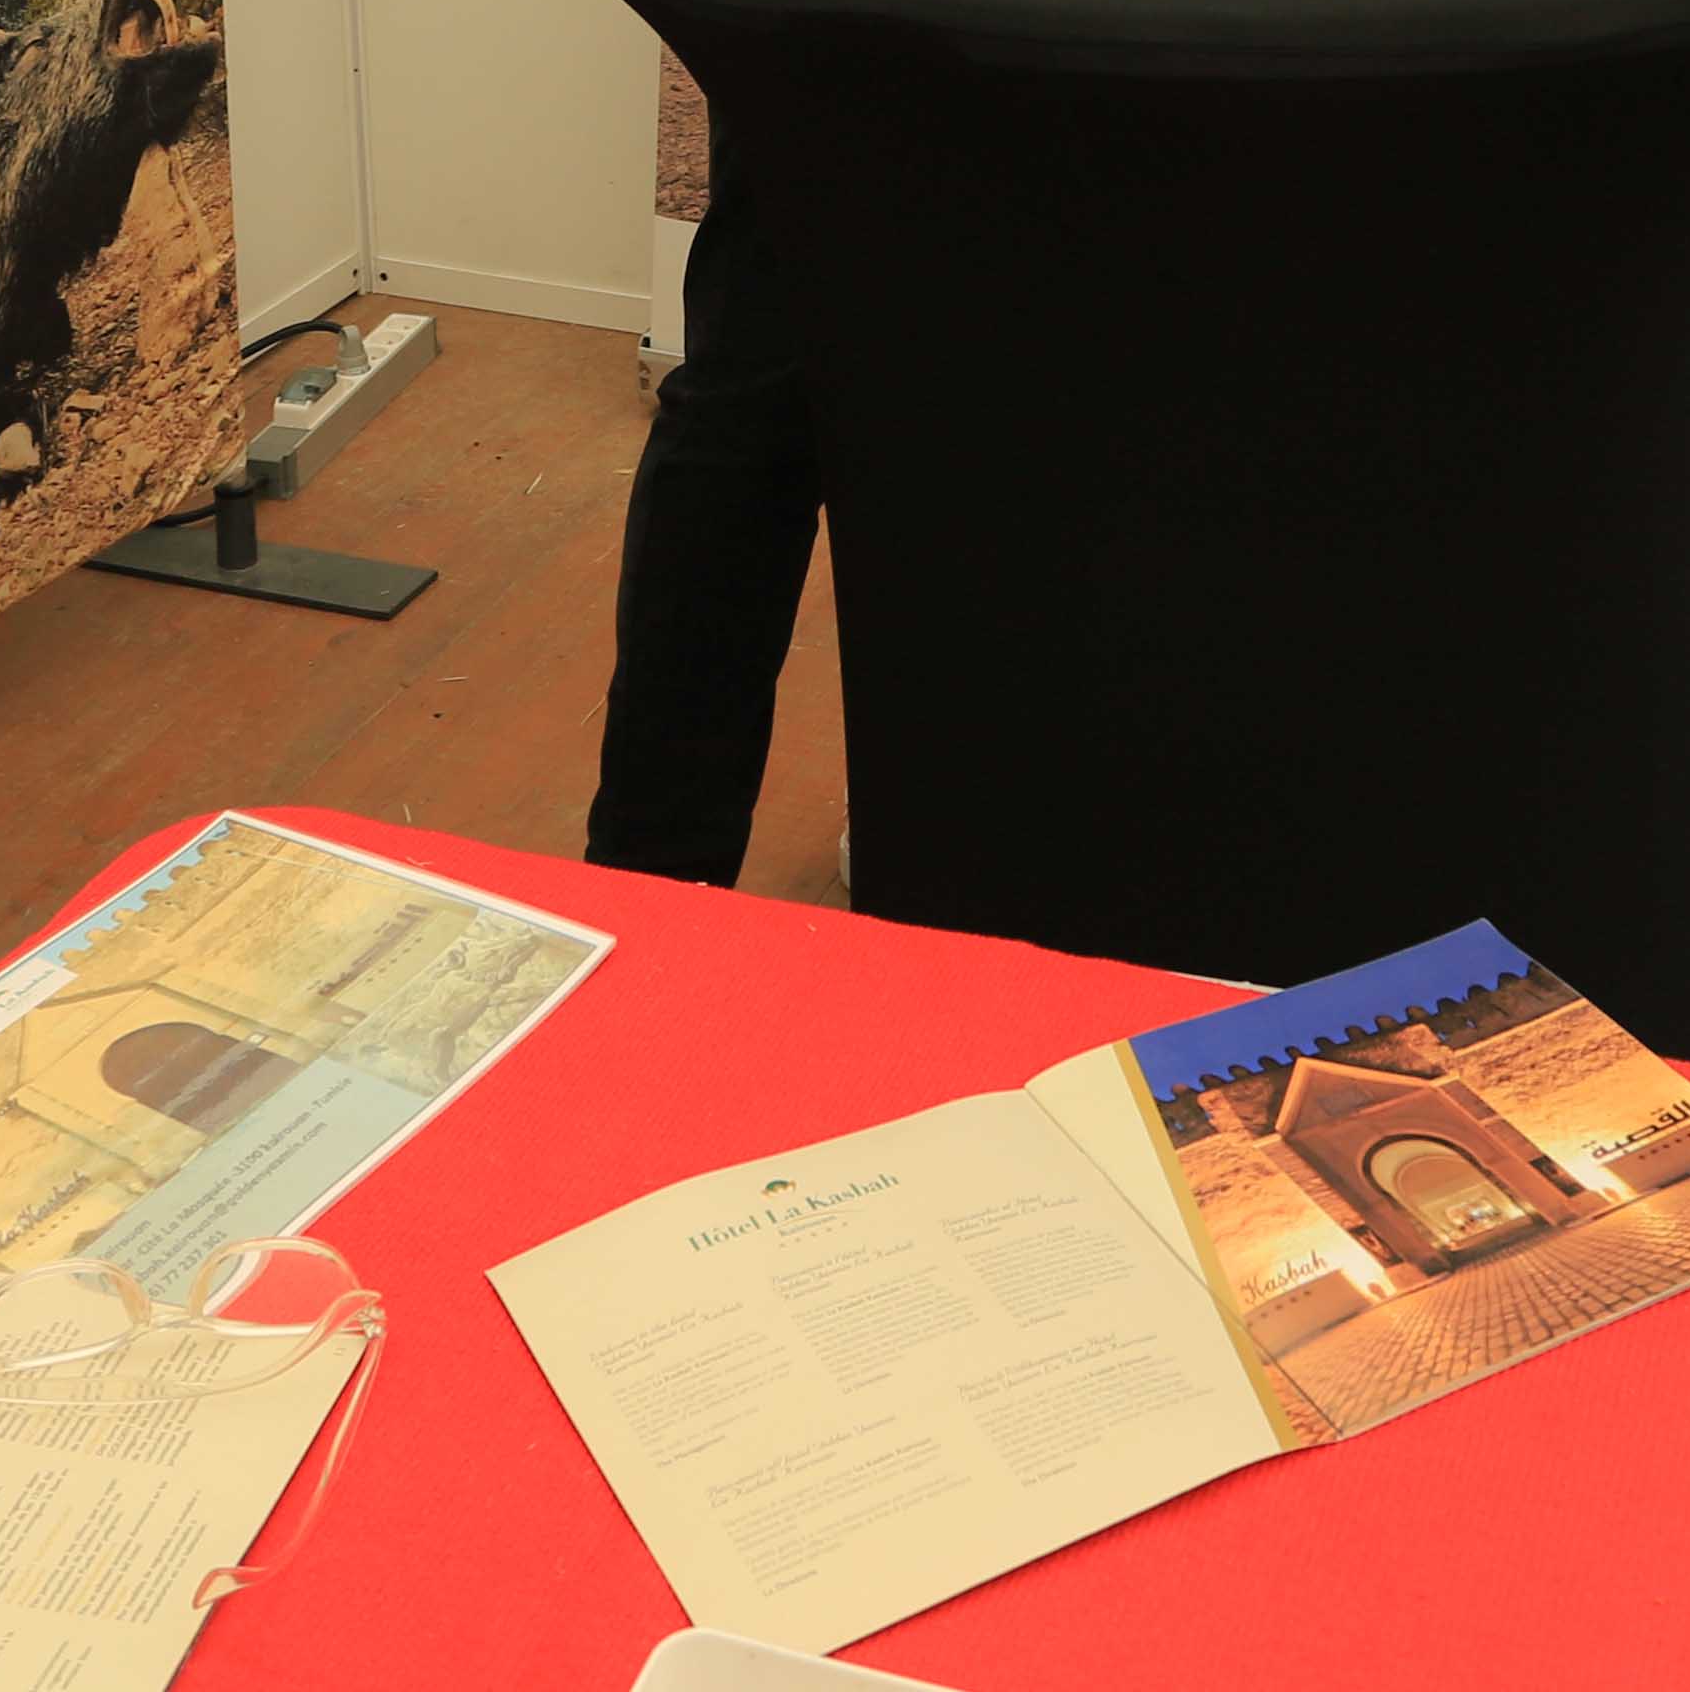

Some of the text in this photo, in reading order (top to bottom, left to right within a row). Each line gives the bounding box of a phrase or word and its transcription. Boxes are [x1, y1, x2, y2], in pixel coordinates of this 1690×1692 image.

[687, 1172, 900, 1253] Hôtel La Kasbah
[1240, 1248, 1328, 1306] Kasbah
